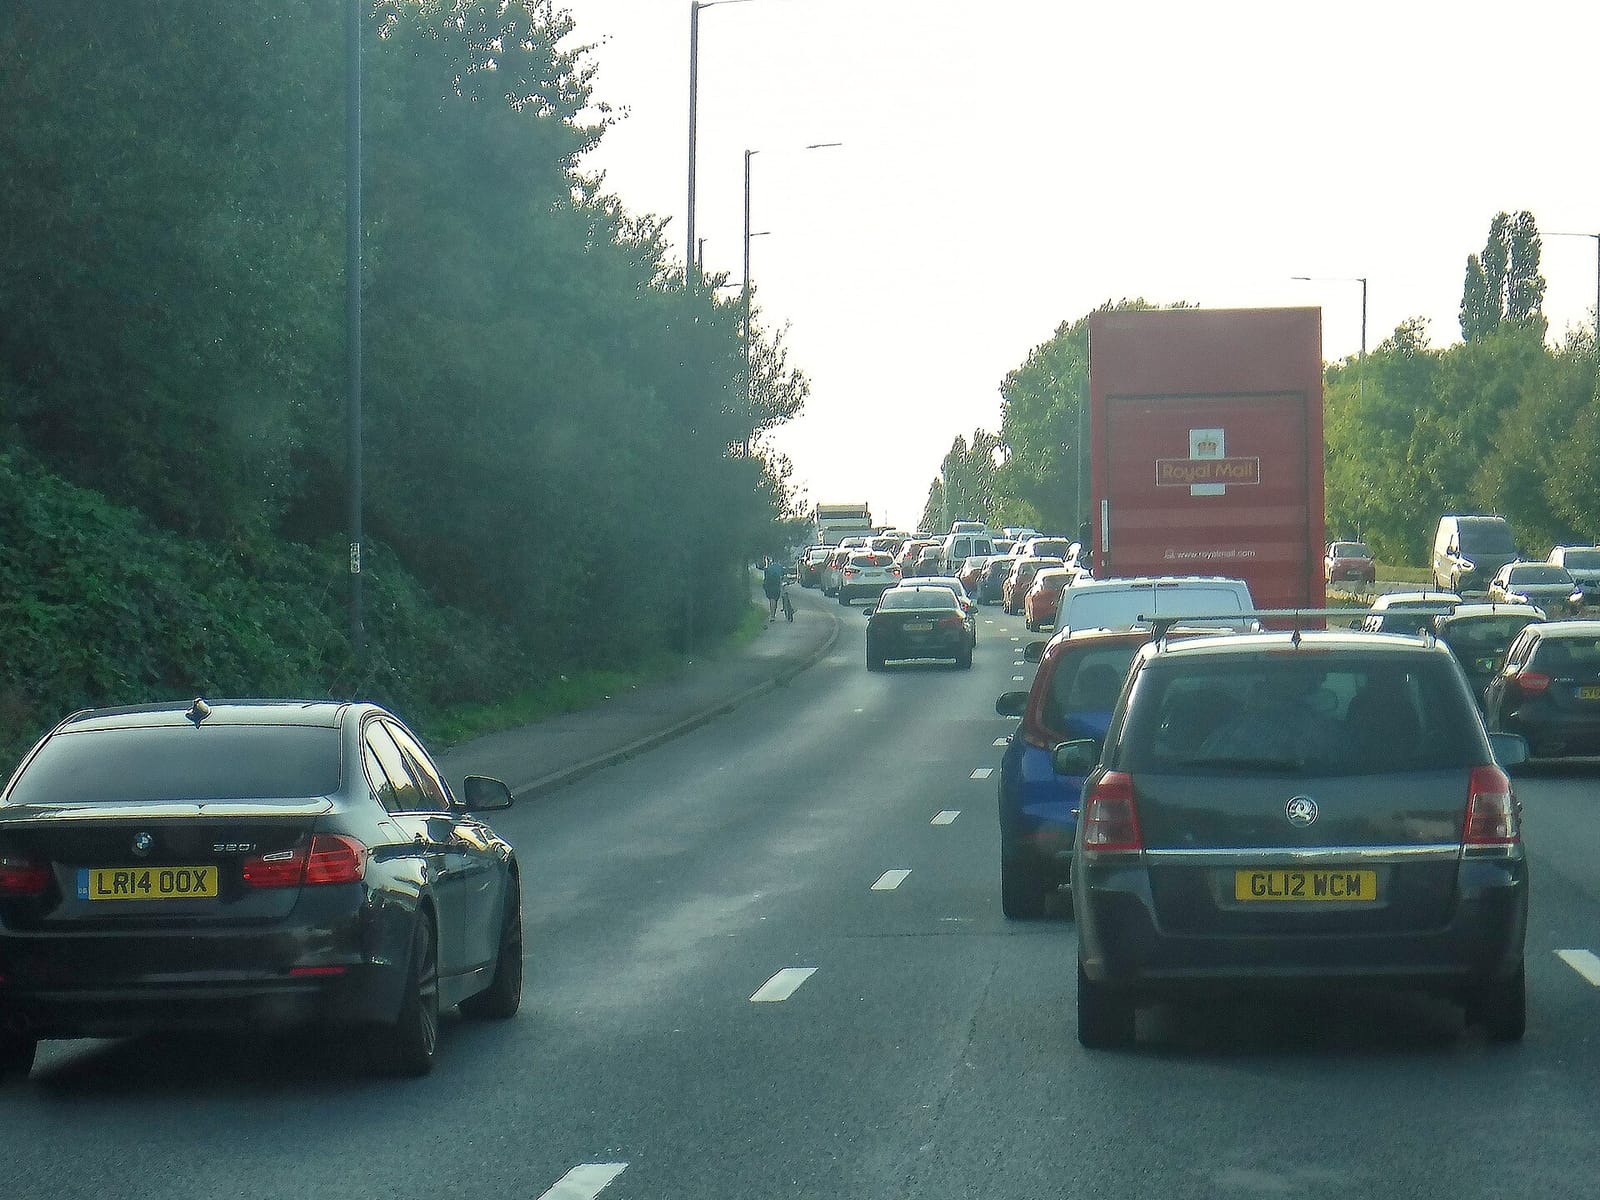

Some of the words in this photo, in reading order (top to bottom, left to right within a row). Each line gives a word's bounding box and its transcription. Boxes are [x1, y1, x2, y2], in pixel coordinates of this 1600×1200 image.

[1164, 464, 1210, 480] Royal
[1215, 463, 1252, 477] Mail
[1177, 549, 1256, 559] www.royalmail.com
[97, 871, 152, 895] LR14
[1251, 873, 1305, 896] GL12
[1313, 873, 1361, 896] WCM
